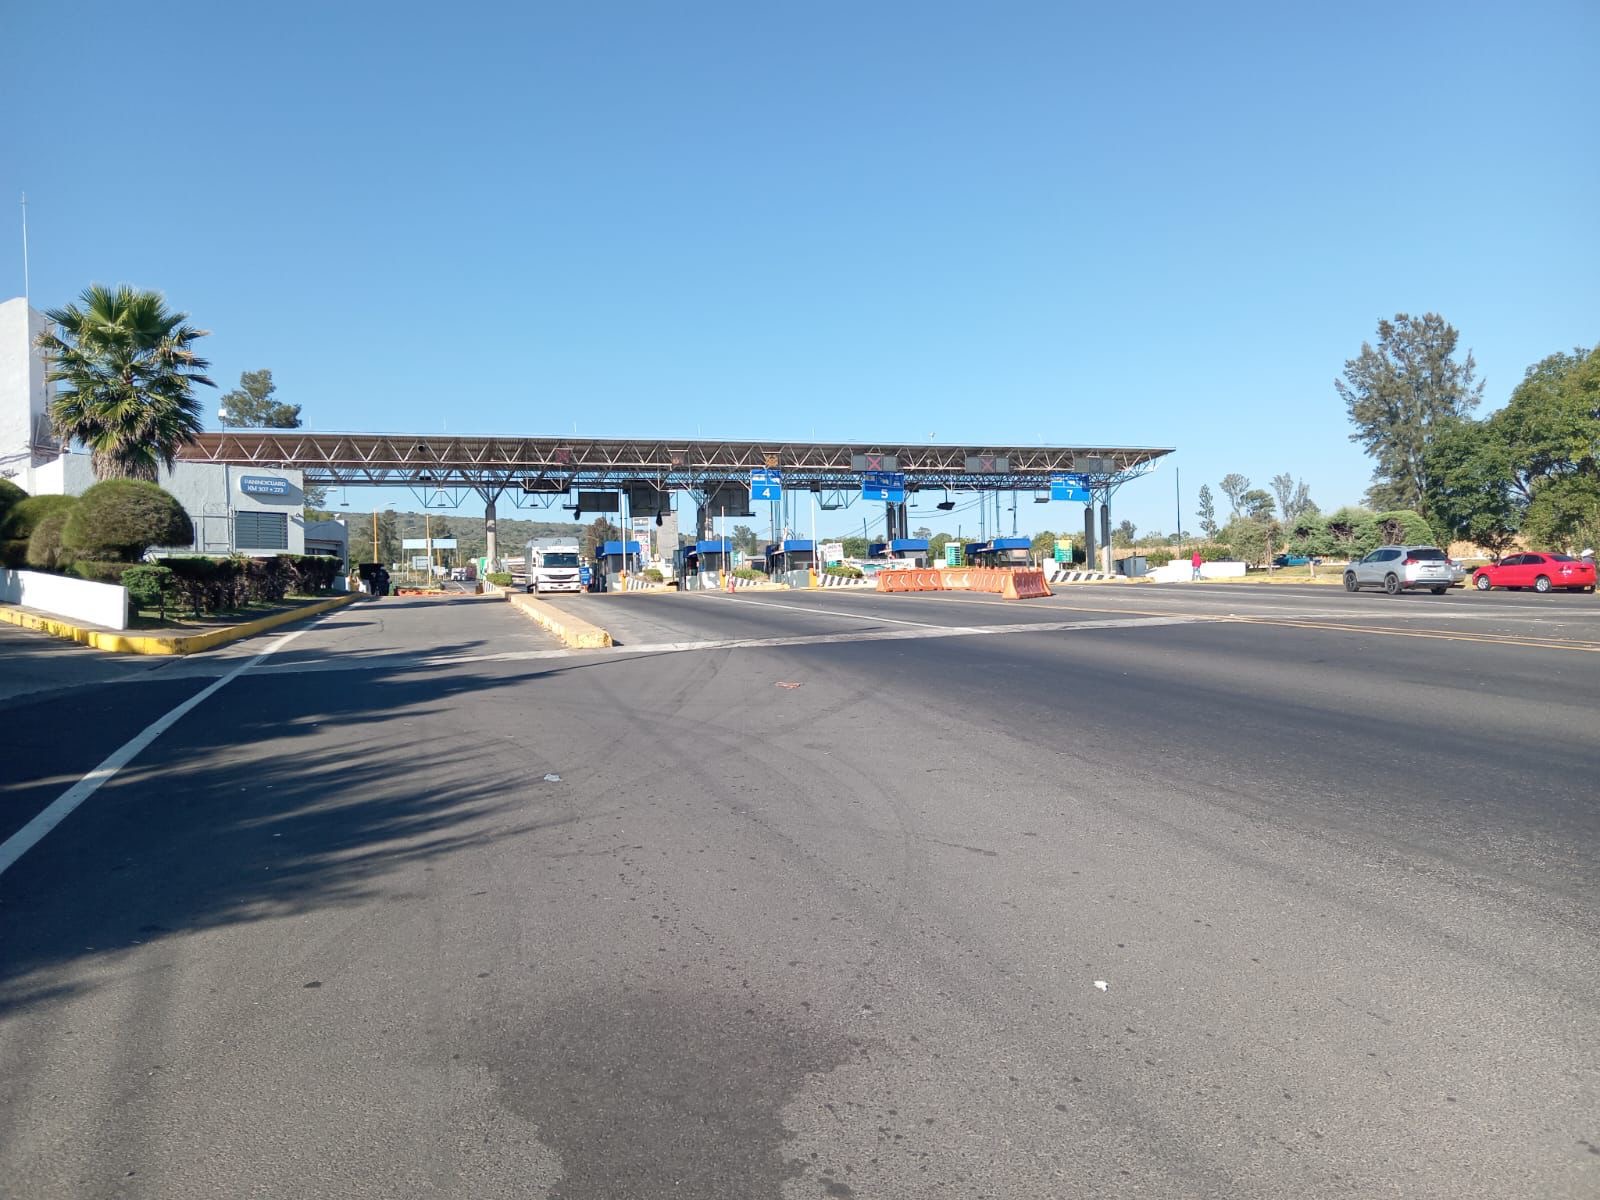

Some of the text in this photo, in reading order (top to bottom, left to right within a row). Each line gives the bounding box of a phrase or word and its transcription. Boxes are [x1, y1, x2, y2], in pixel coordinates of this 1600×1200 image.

[762, 488, 770, 497] 4
[881, 490, 888, 498] 5
[1066, 489, 1074, 499] 7
